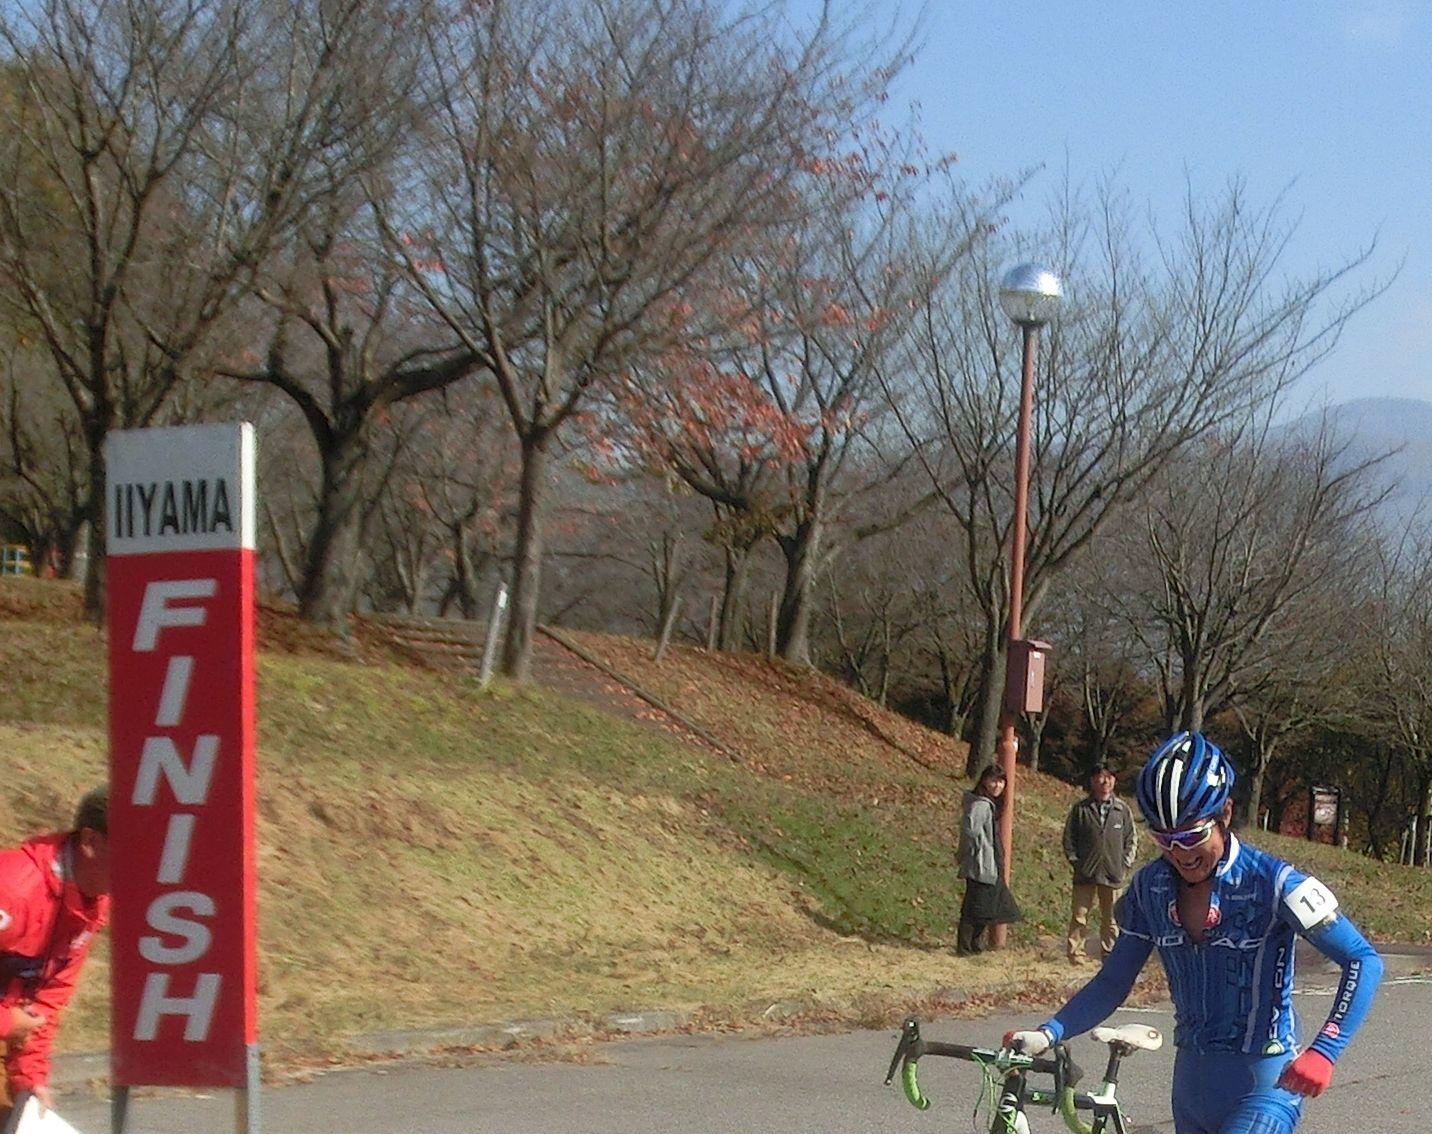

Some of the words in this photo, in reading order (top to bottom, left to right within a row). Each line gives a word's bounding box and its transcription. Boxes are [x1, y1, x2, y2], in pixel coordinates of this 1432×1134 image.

[115, 478, 233, 537] IIYAMA
[132, 578, 222, 1042] FINISH
[1300, 887, 1326, 913] 13
[1335, 960, 1361, 1019] TORQUE
